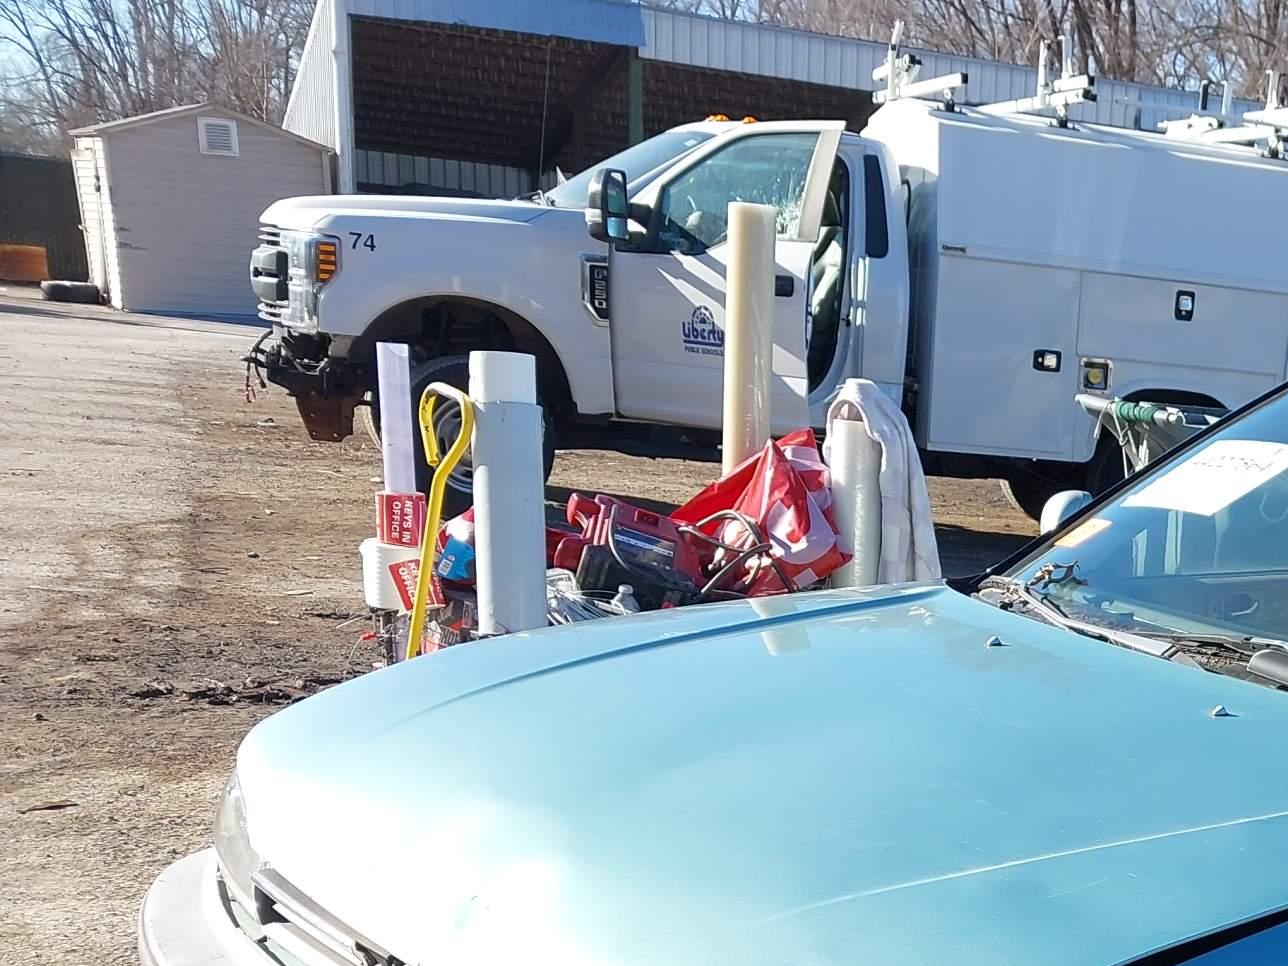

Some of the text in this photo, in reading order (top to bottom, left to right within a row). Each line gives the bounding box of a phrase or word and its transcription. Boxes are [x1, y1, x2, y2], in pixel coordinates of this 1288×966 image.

[349, 231, 376, 252] 74
[682, 319, 725, 346] Liberty
[391, 500, 402, 539] OFFICE
[401, 499, 414, 544] KEYS IN
